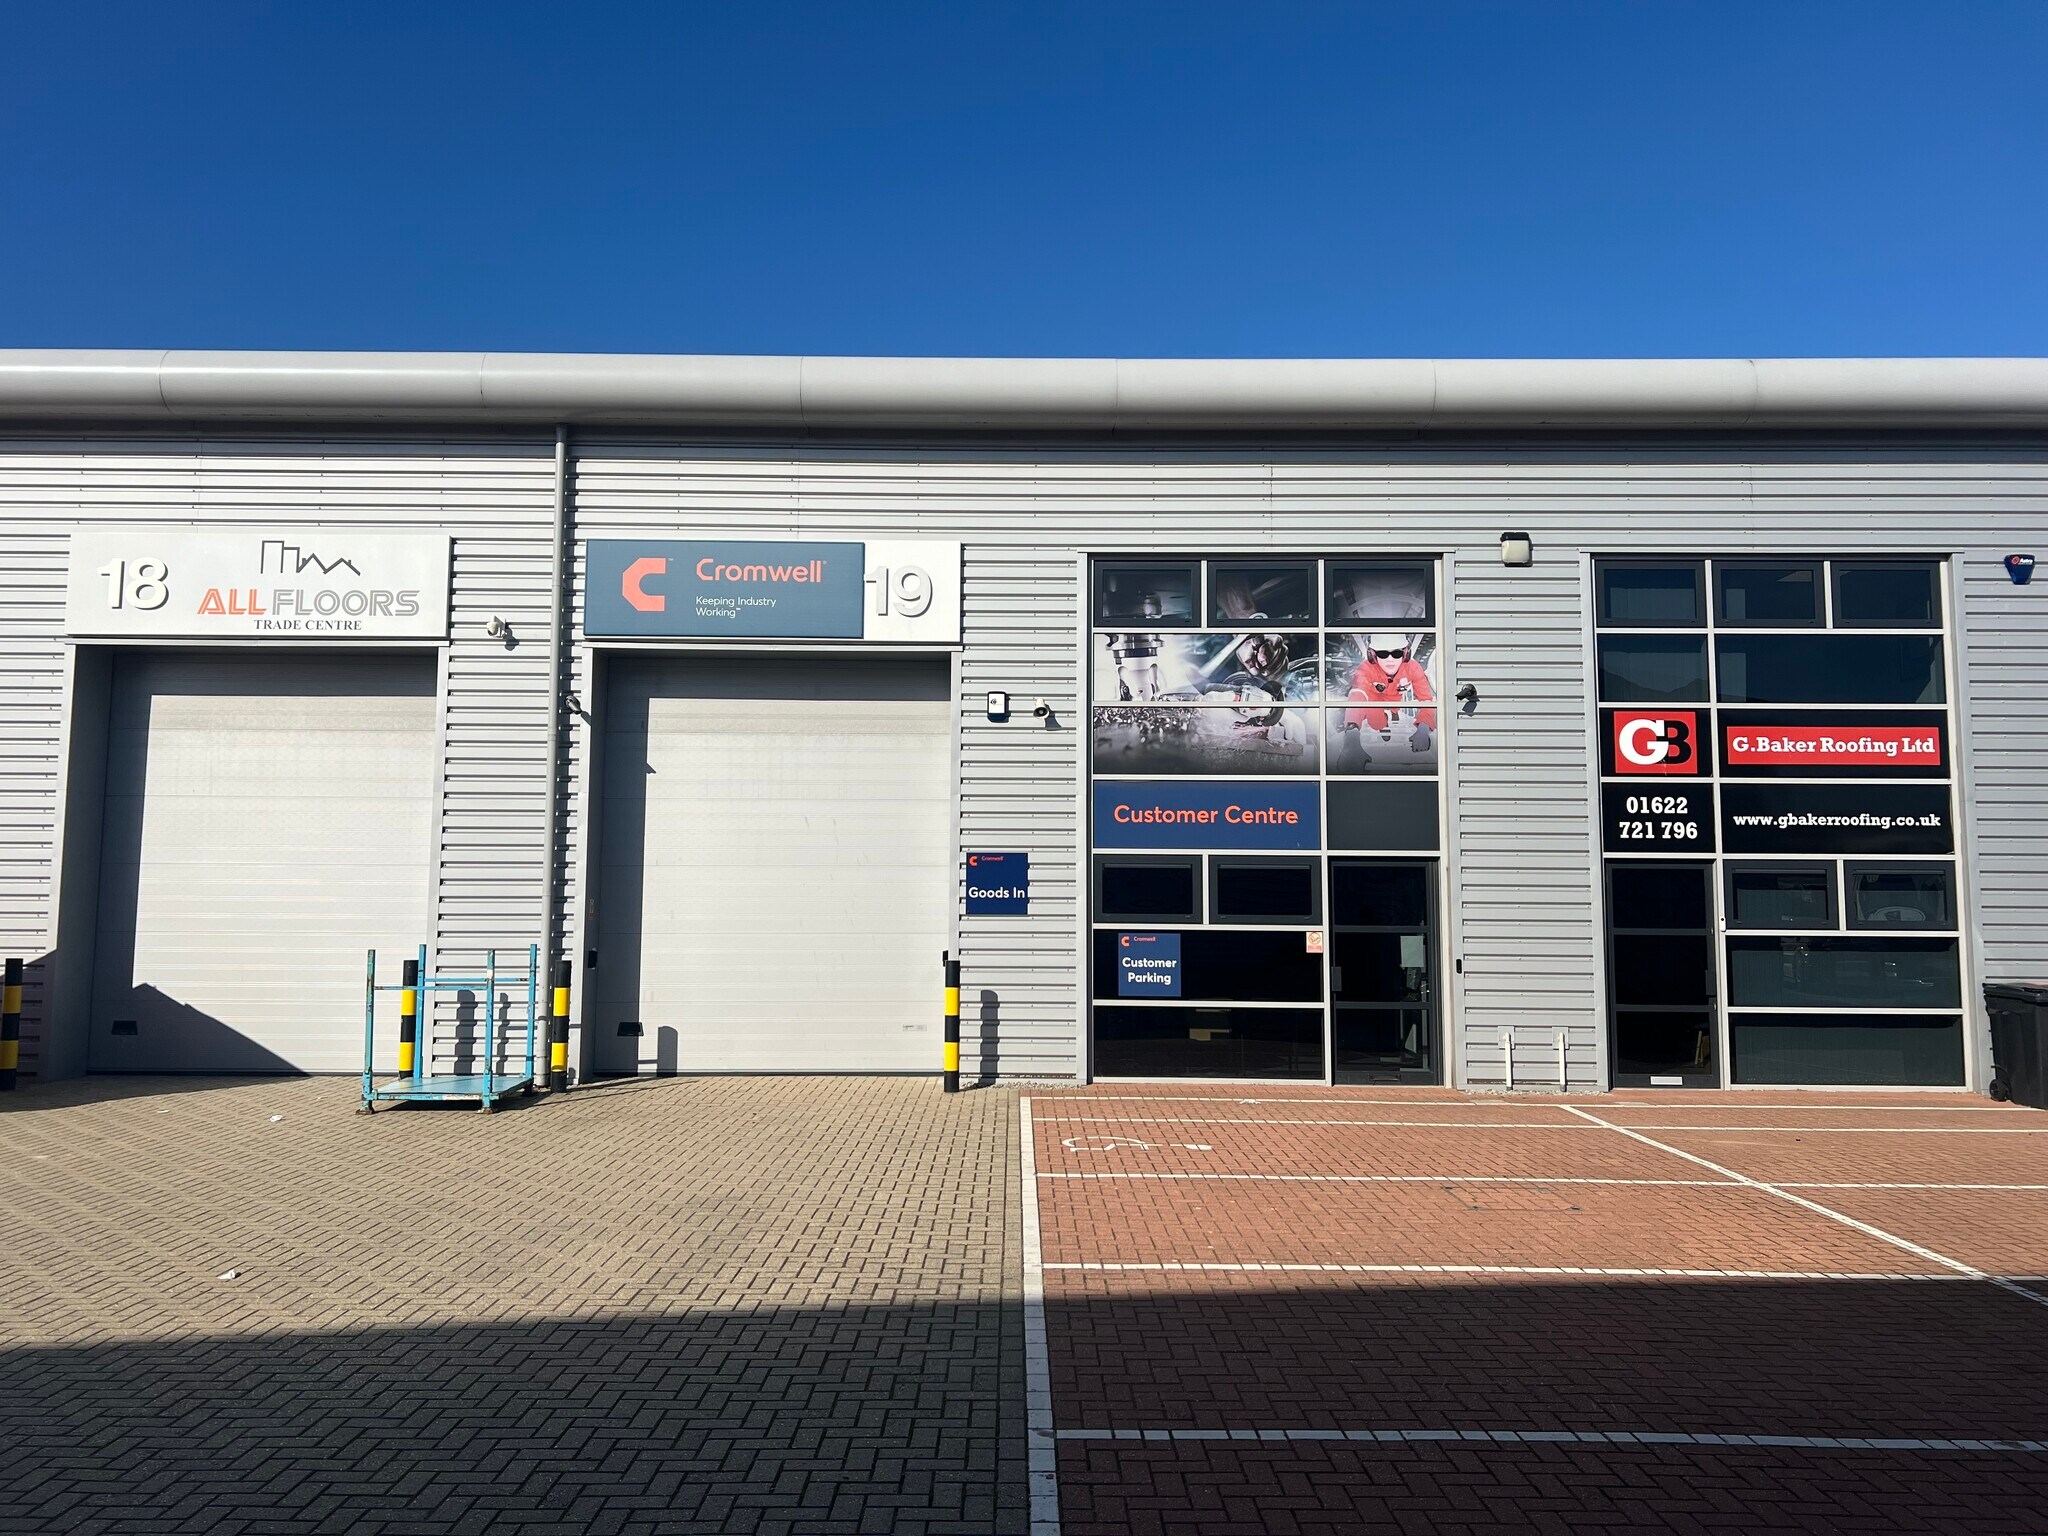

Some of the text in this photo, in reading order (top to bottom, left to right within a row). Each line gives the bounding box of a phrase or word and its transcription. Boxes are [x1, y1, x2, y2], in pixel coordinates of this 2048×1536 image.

[696, 558, 823, 583] Cromwell
[97, 557, 169, 610] 18
[864, 565, 933, 617] 19
[696, 596, 777, 608] Keeping Industry
[254, 619, 362, 631] TRADE CENTRE
[1732, 737, 1936, 757] G.Baker Roofing Ltd
[1113, 804, 1299, 824] Customer Centre
[1626, 797, 1688, 814] 01622
[1733, 813, 1941, 829] www.gbakerroofing.co.uk
[1619, 822, 1698, 839] 721 796
[968, 886, 1025, 899] Goods In
[1122, 957, 1177, 968] Customer
[1127, 971, 1172, 985] Parking
